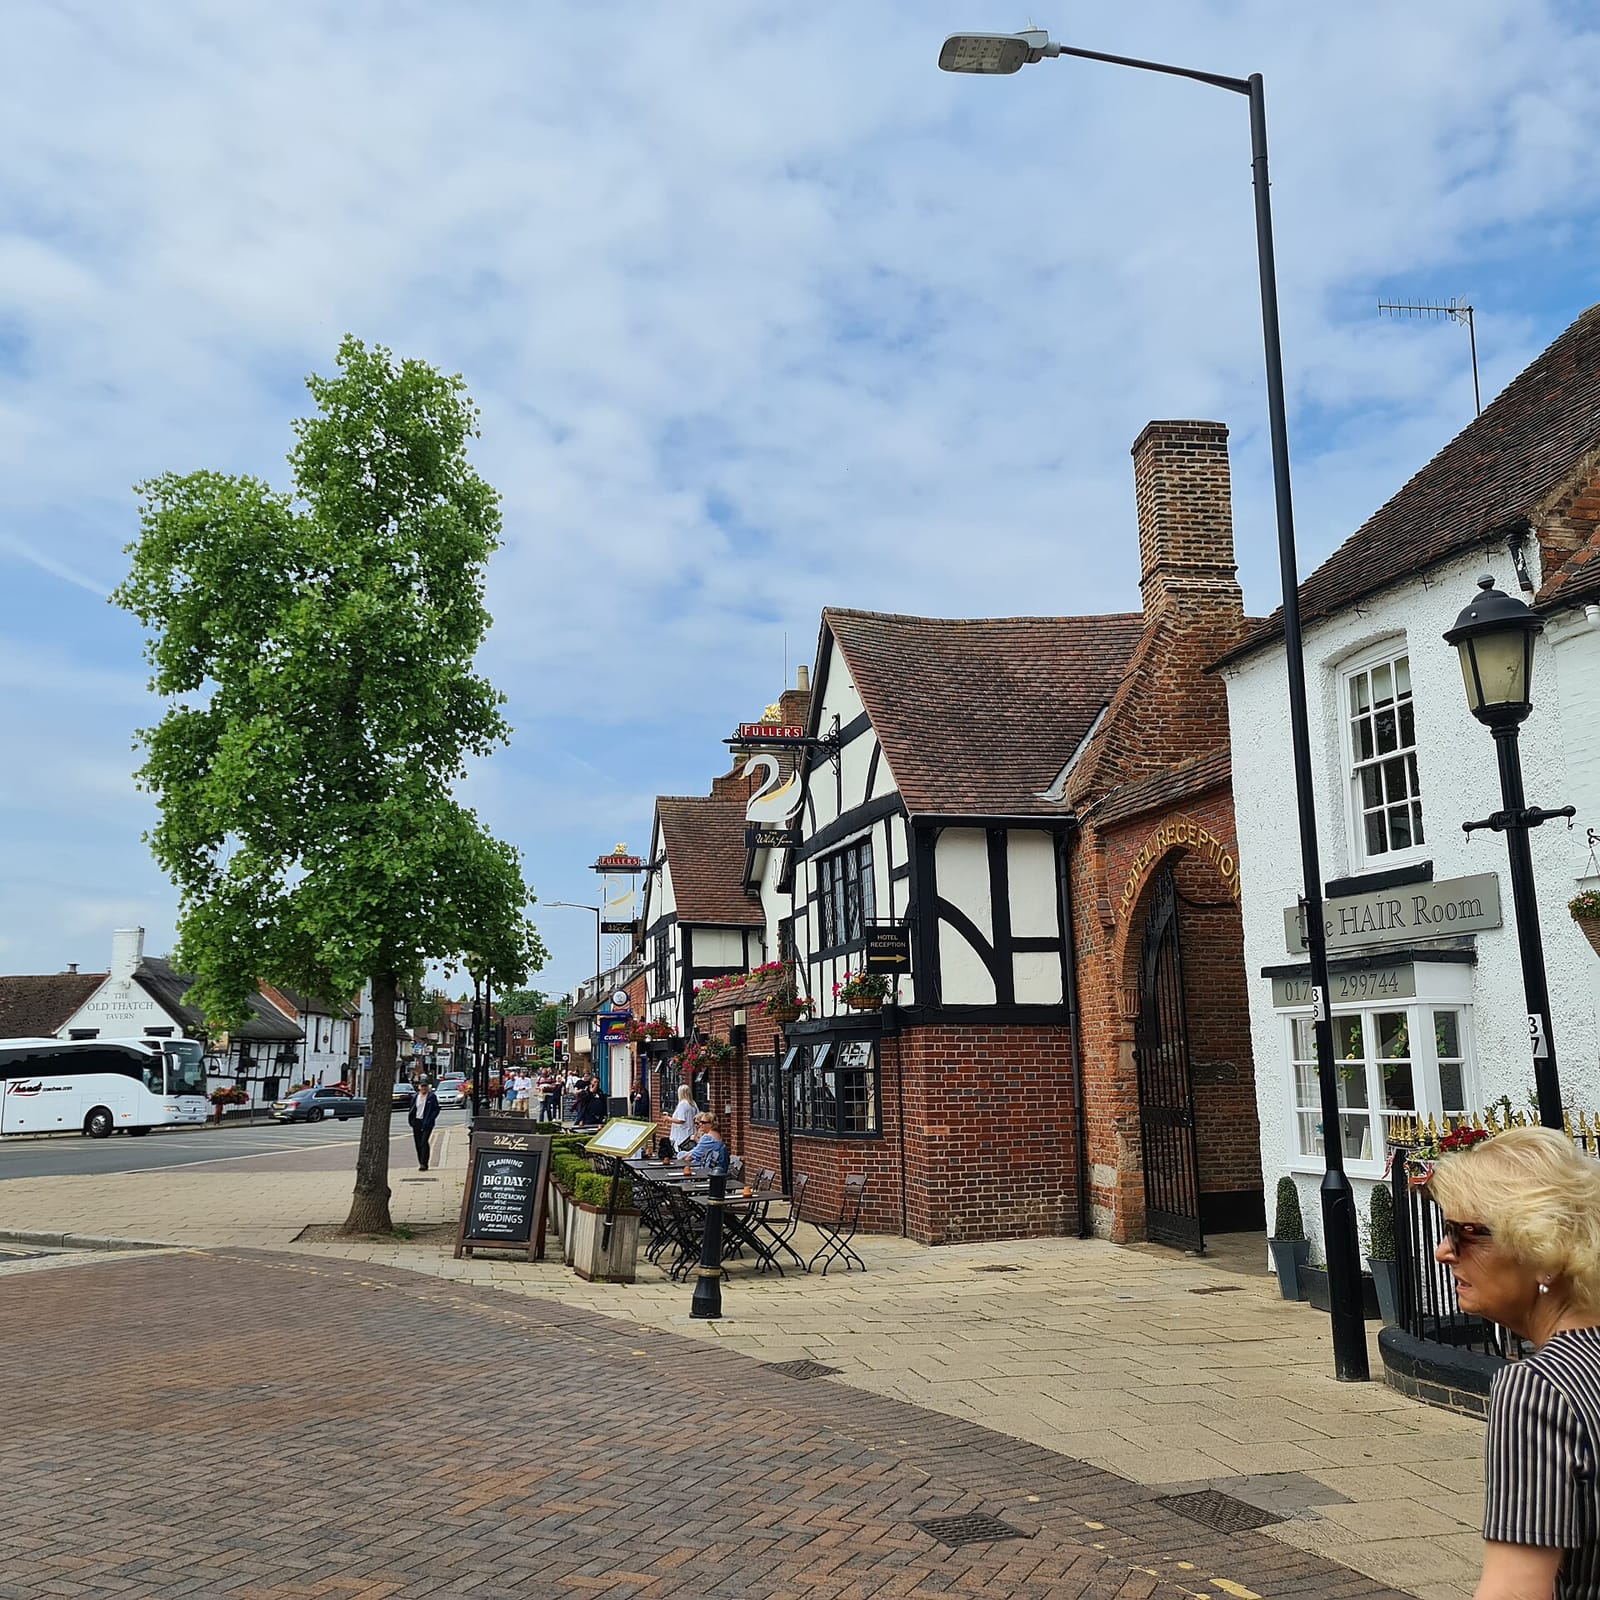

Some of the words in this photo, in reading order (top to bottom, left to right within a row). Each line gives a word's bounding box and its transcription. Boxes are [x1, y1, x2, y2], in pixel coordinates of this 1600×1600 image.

[744, 725, 801, 738] FULLER'S
[1119, 839, 1157, 920] HOTEL
[1337, 899, 1406, 937] HAIR
[1411, 895, 1484, 927] Room
[1285, 980, 1311, 1001] 017
[1339, 970, 1399, 998] 299744
[87, 1002, 109, 1011] OLD
[111, 1001, 154, 1011] THATCH
[105, 1012, 135, 1020] TAVERN
[487, 1158, 524, 1168] PLANNING
[482, 1175, 502, 1186] BIG
[503, 1175, 532, 1187] DAY?
[494, 1192, 527, 1201] CEREMONY
[478, 1212, 524, 1224] WEDDINGS
